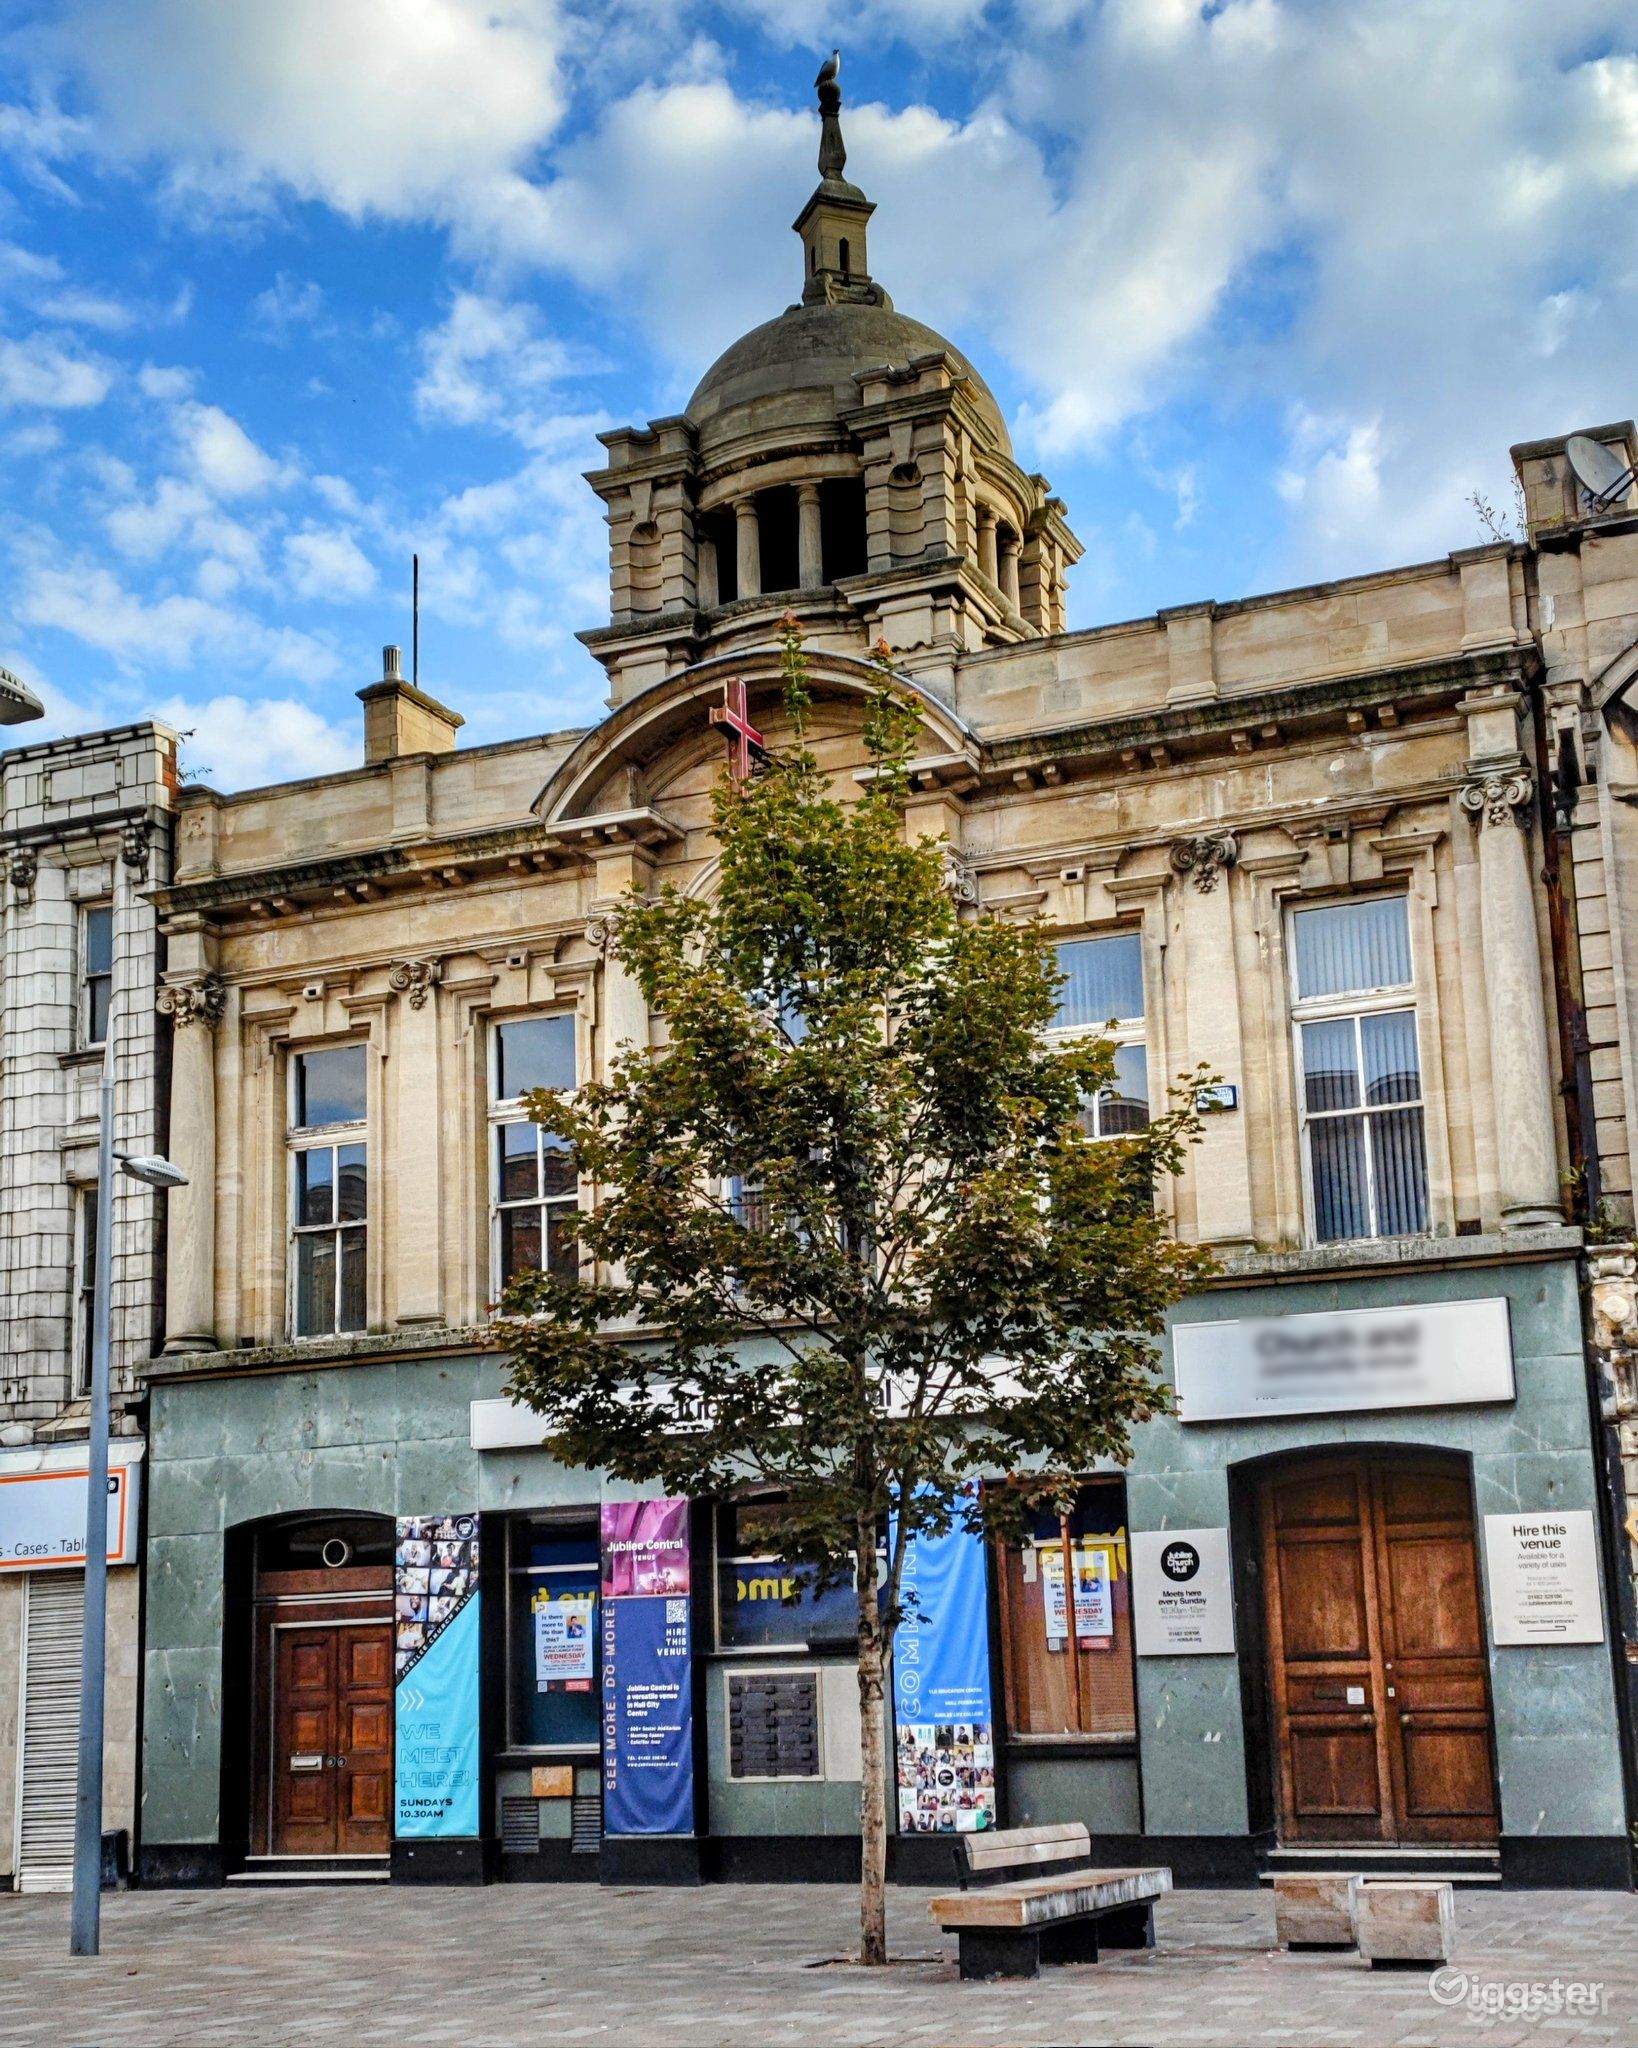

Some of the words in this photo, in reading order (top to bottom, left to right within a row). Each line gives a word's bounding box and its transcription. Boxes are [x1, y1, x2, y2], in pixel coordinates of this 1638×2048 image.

[1513, 1525, 1540, 1537] Hire
[1542, 1524, 1567, 1536] this
[15, 1543, 48, 1556] Cases
[60, 1538, 87, 1552] Tabl
[607, 1541, 644, 1552] Jubilee
[646, 1538, 683, 1550] Central
[1520, 1539, 1562, 1550] venue
[1167, 1551, 1193, 1560] Jubilee
[1517, 1552, 1548, 1560] Available
[1167, 1558, 1194, 1567] Church
[1518, 1562, 1540, 1570] variety
[1541, 1561, 1549, 1569] of
[1172, 1566, 1187, 1574] Hull
[1179, 1597, 1206, 1605] Sunday
[401, 1642, 428, 1676] JUBILEE
[429, 1613, 454, 1645] CHURCH
[455, 1592, 473, 1615] HULL
[666, 1628, 687, 1636] HIRE
[666, 1638, 687, 1646] THIS
[543, 1652, 586, 1660] WEDNESDAY
[657, 1648, 687, 1657] VENUE
[605, 1664, 616, 1688] DO
[626, 1684, 650, 1692] Jubilee
[650, 1683, 673, 1691] Central
[646, 1700, 660, 1709] City
[627, 1709, 648, 1717] Centre
[400, 1723, 441, 1740] WE
[400, 1746, 465, 1764] MEET
[606, 1758, 617, 1790] SEE
[400, 1770, 470, 1788] HERE!
[400, 1798, 453, 1807] SUNDAYS
[400, 1810, 444, 1819] 10.30AM
